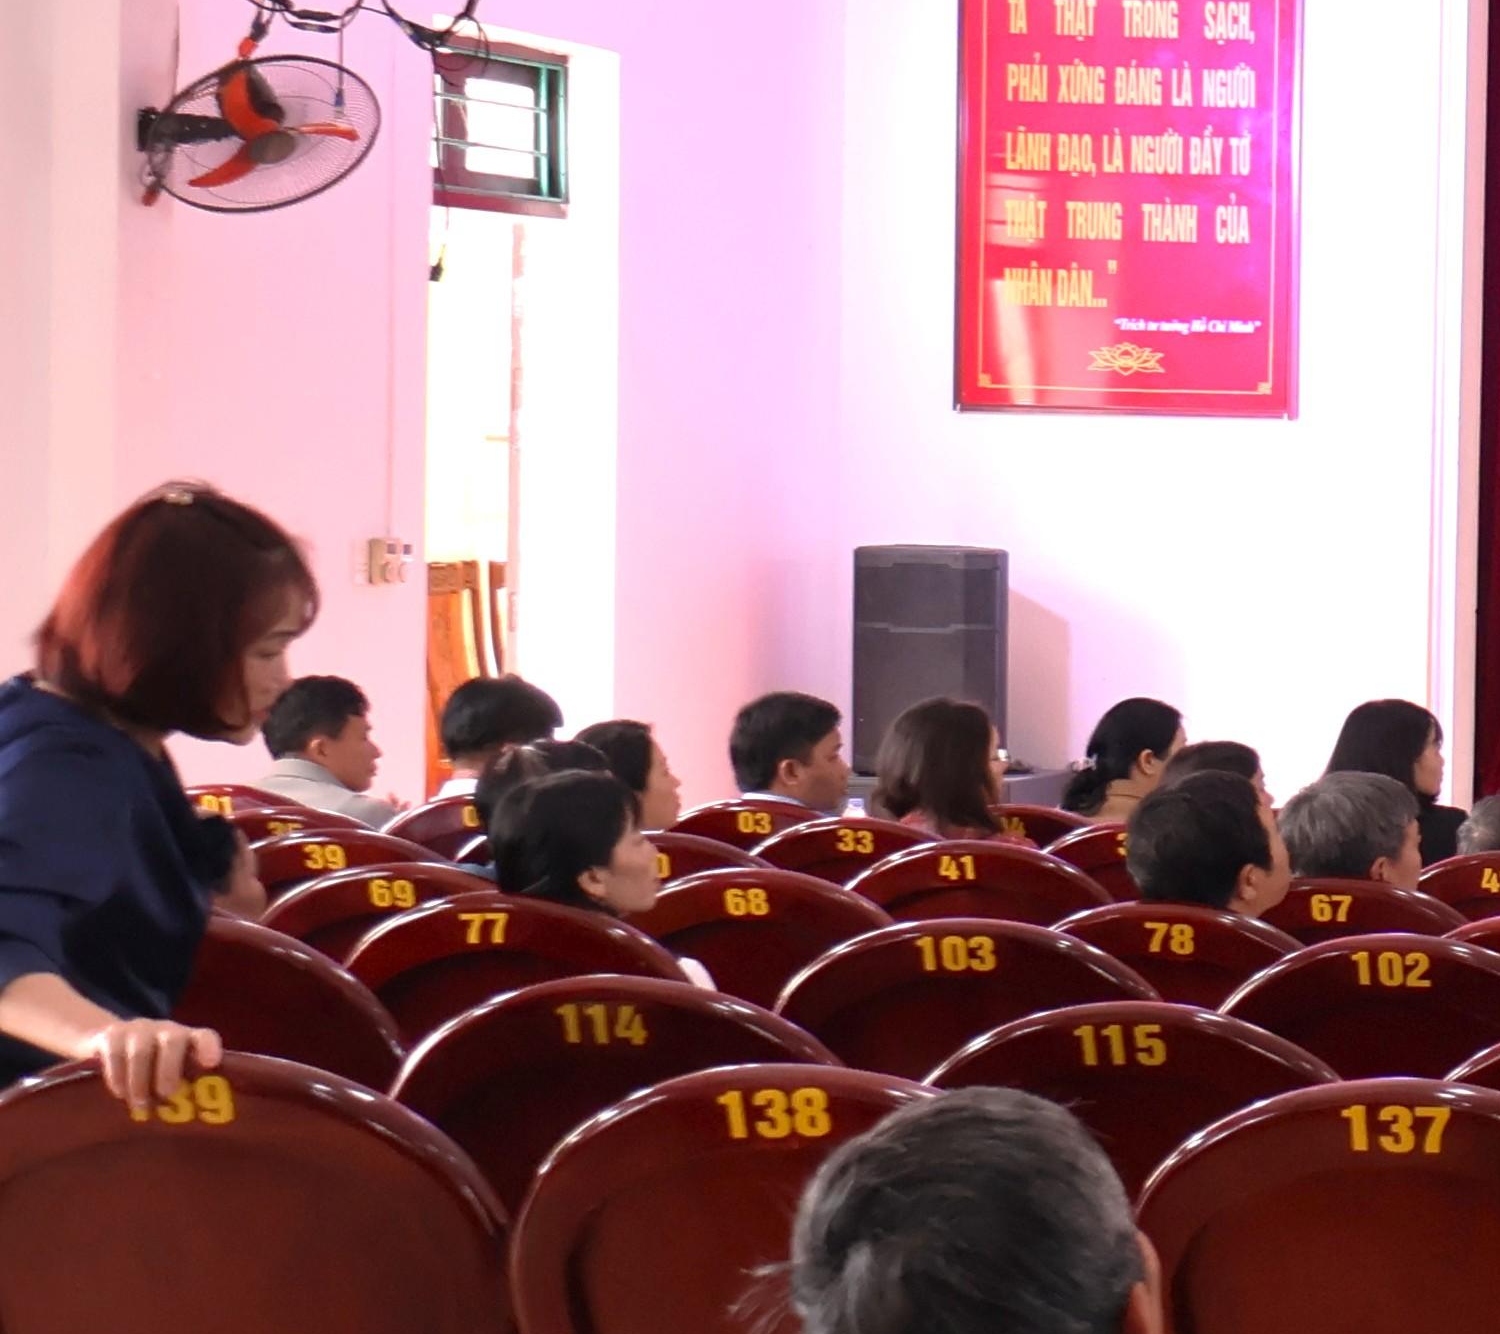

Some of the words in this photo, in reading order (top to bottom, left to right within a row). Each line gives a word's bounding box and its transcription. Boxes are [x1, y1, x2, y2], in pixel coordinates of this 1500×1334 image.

[738, 812, 771, 833] 03
[837, 829, 873, 853] 33
[304, 844, 345, 869] 39
[939, 856, 974, 880] 41
[369, 879, 415, 907] 69
[724, 888, 768, 915] 68
[1311, 894, 1352, 921] 67
[458, 913, 508, 943] 77
[1144, 922, 1194, 954] 78
[915, 936, 995, 971] 103
[1351, 951, 1430, 987] 102
[556, 1004, 646, 1044] 114
[1074, 1024, 1166, 1065] 115
[718, 1088, 830, 1138] 138
[1342, 1105, 1450, 1153] 137
